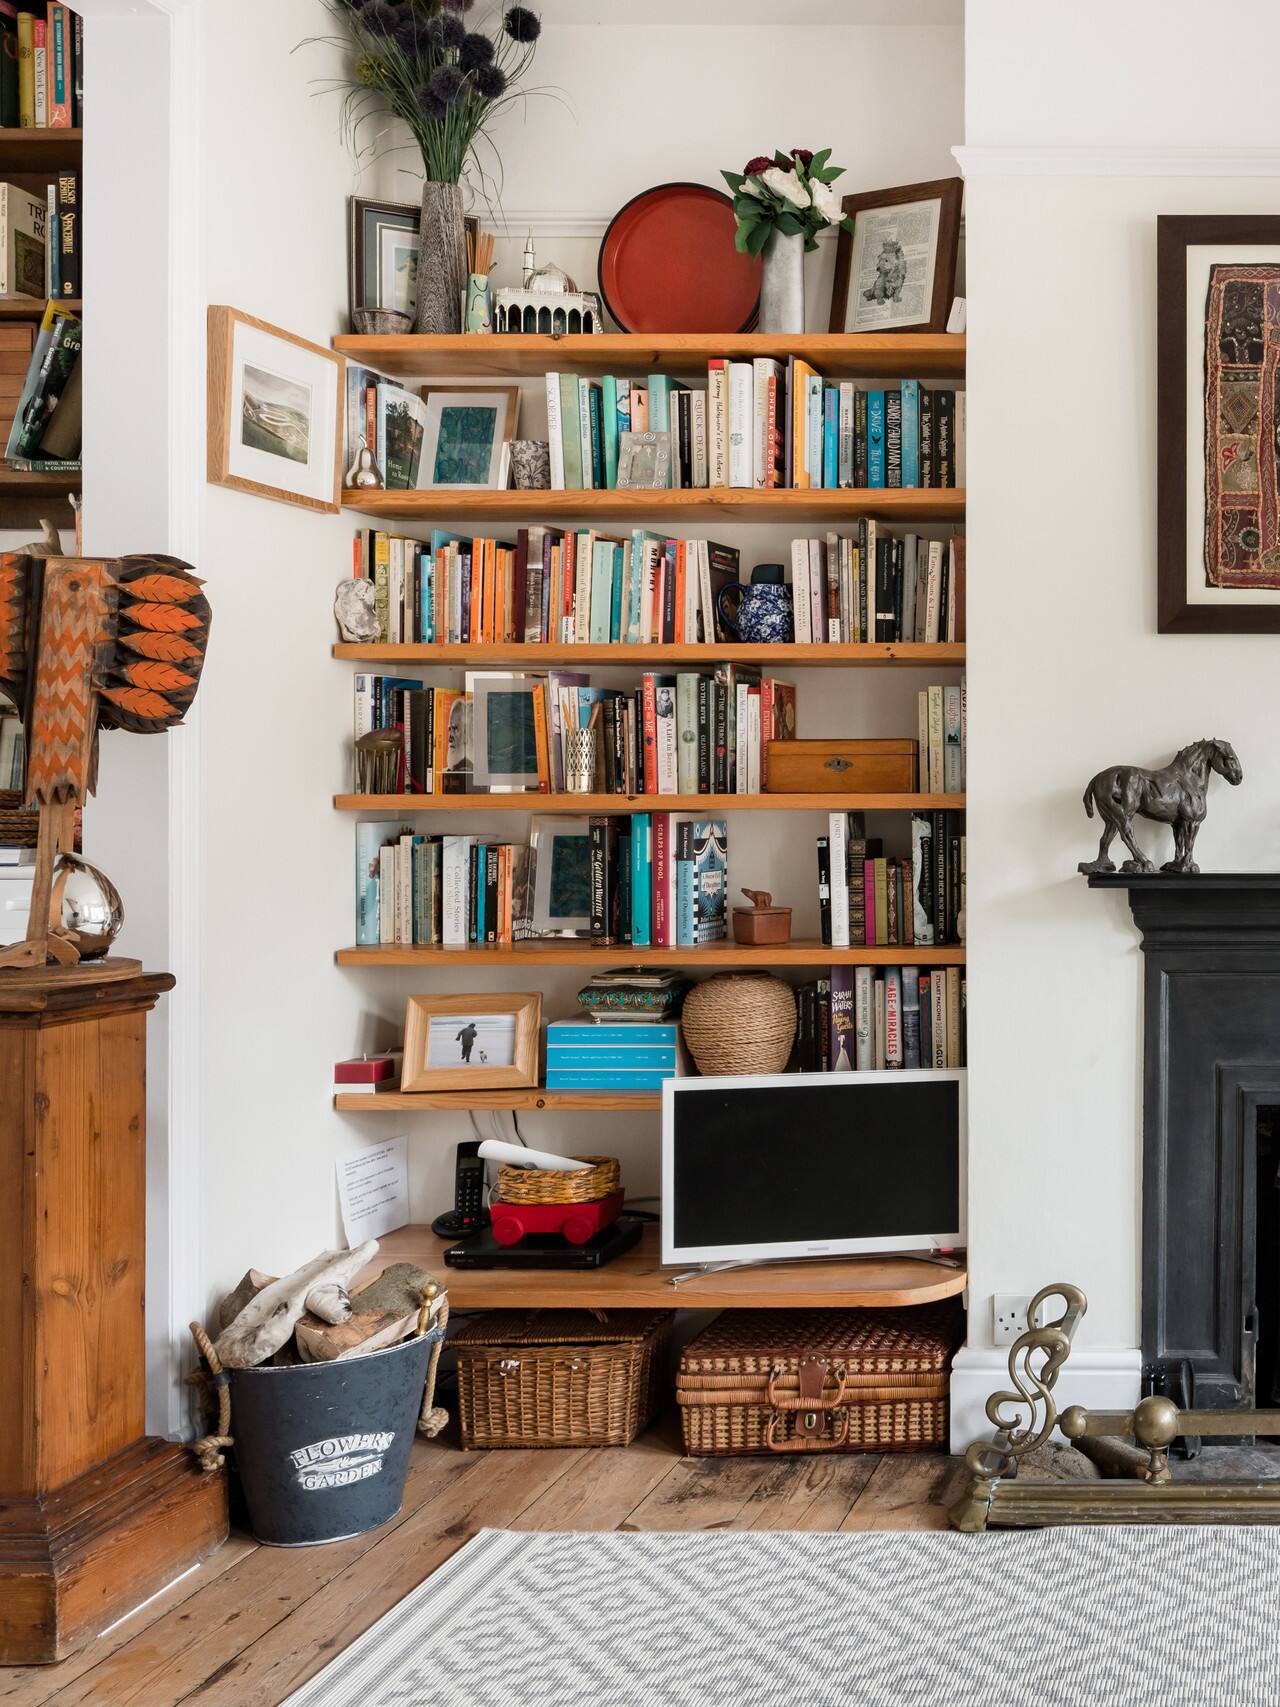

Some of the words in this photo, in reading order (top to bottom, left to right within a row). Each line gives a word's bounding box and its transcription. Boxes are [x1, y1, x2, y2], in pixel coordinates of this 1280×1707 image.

[36, 50, 44, 68] New
[37, 70, 45, 90] York
[872, 411, 881, 433] DRIVE
[700, 682, 705, 692] TO
[658, 850, 663, 859] OF
[887, 988, 896, 1004] AGE
[888, 1011, 897, 1055] MIRACLES
[304, 1459, 382, 1488] GARDEN
